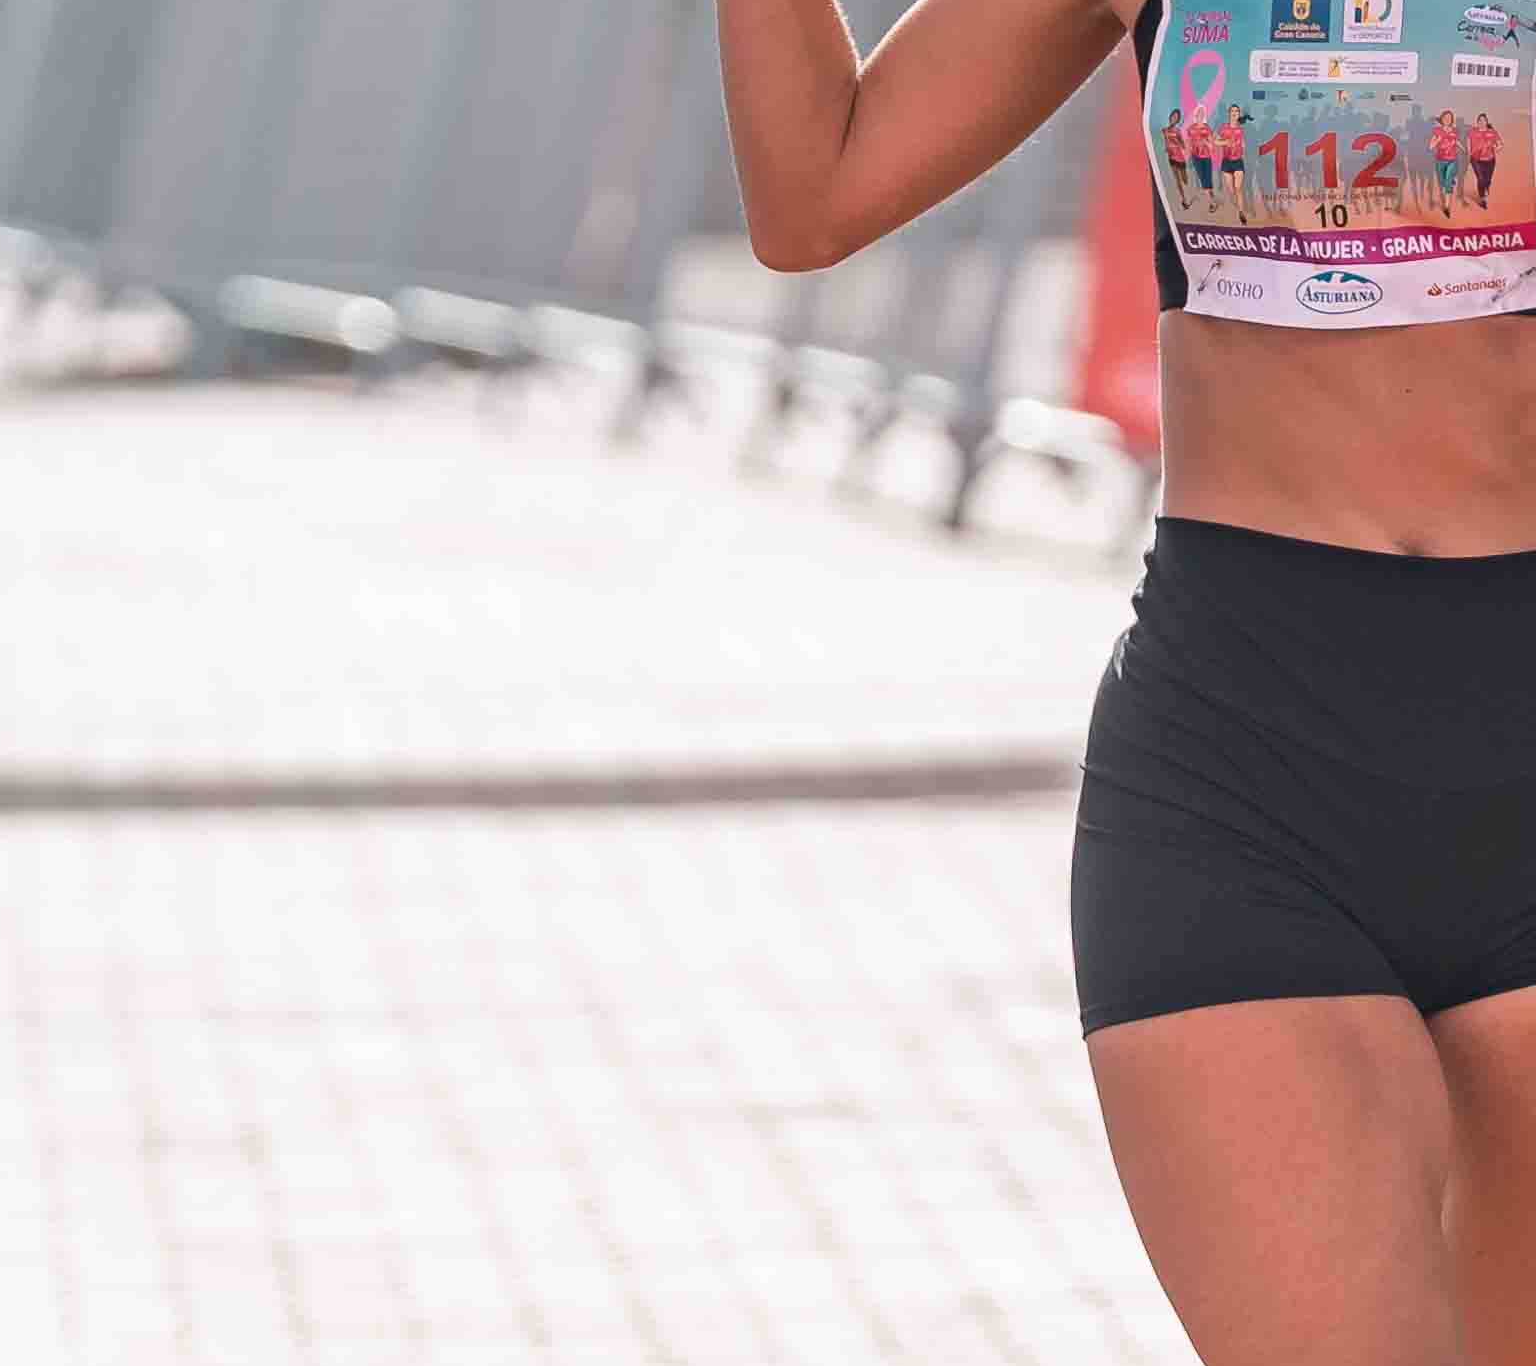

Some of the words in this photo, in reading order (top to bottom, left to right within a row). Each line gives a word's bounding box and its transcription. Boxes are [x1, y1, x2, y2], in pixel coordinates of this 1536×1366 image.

[1183, 26, 1230, 43] SUMA
[1259, 131, 1400, 189] 112
[1314, 203, 1348, 228] 10
[1186, 232, 1258, 252] CARRERA
[1259, 236, 1277, 253] DE
[1279, 237, 1301, 255] LA
[1303, 240, 1365, 259] MUJER
[1382, 235, 1434, 258] GRAN
[1439, 232, 1525, 251] CANARIA
[1216, 278, 1264, 300] OYSHO
[1302, 286, 1377, 304] ASTURIANA
